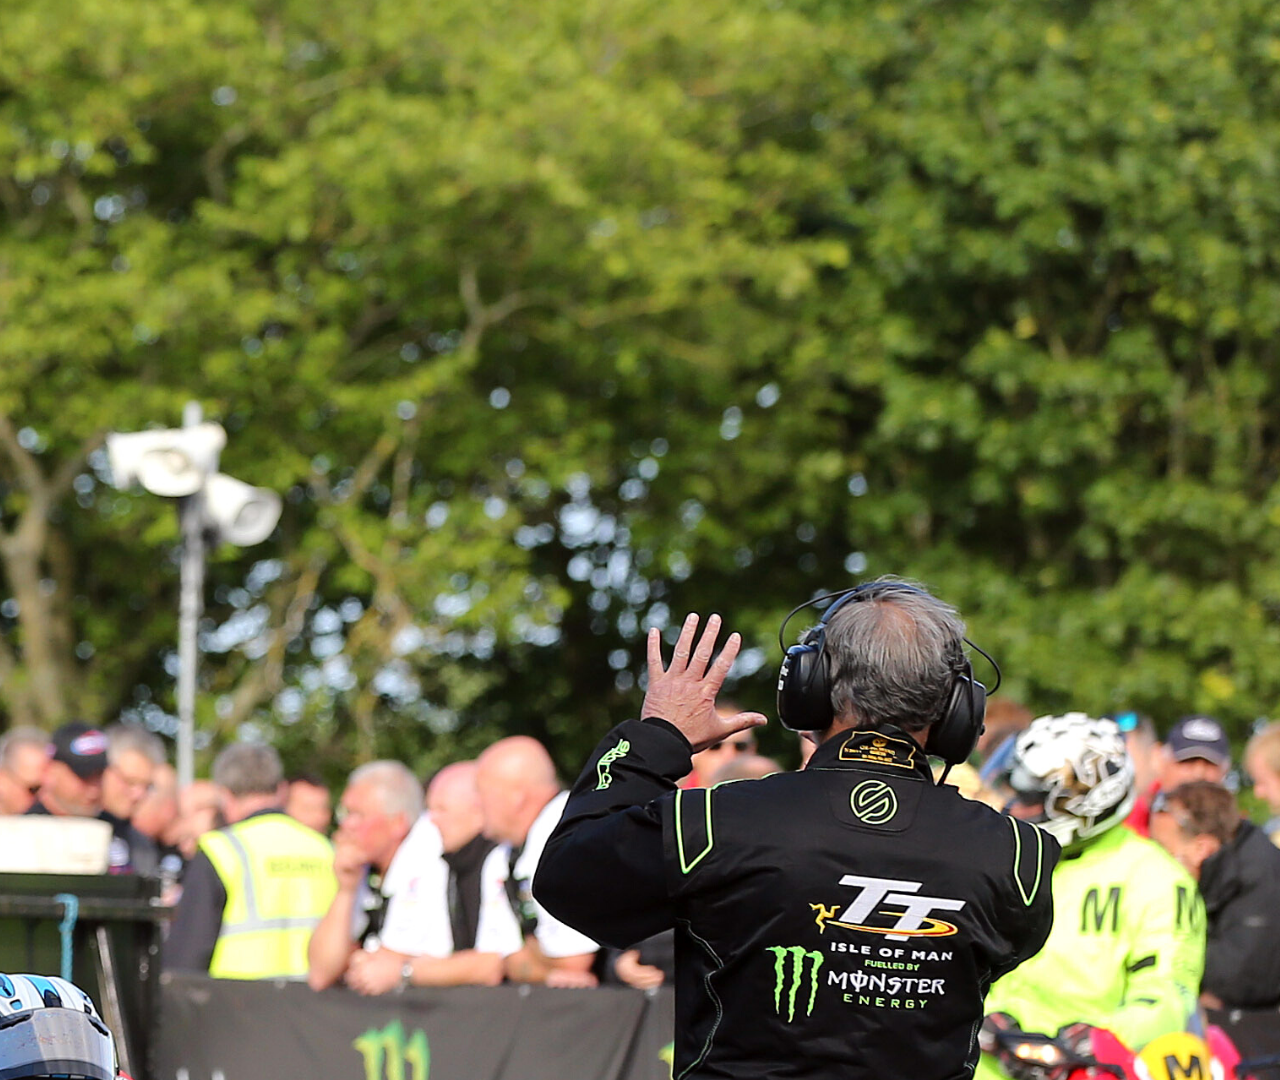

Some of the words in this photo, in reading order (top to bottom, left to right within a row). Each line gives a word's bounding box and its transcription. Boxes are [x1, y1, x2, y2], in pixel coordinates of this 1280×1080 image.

[839, 875, 966, 942] TT
[1081, 887, 1121, 932] M
[830, 942, 871, 955] ISLE
[879, 947, 904, 958] OF
[911, 951, 953, 961] MAN
[864, 959, 905, 970] FUELLED
[906, 963, 920, 971] BY
[827, 970, 945, 995] MONSTER
[843, 993, 928, 1009] ENERGY
